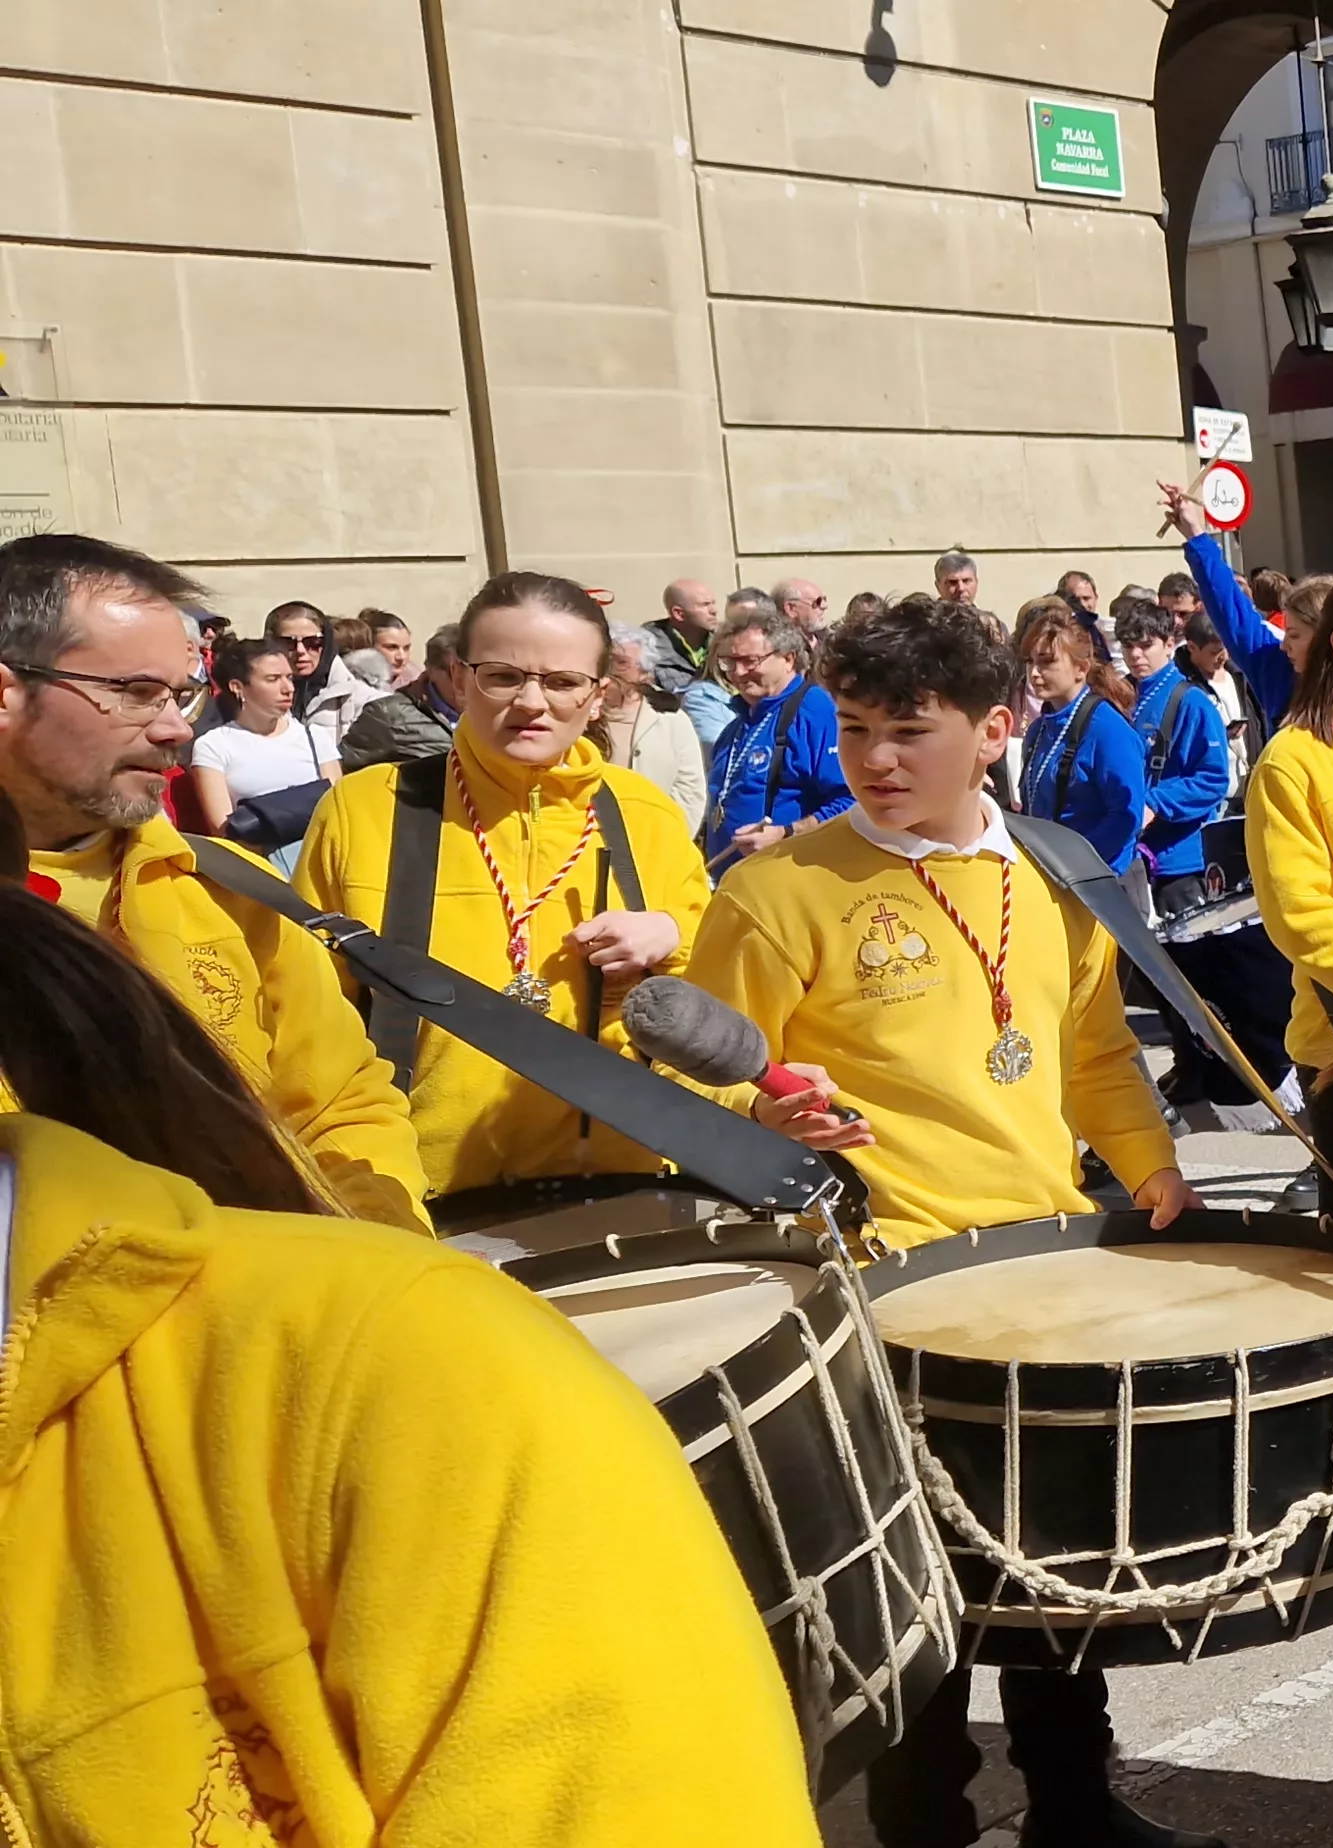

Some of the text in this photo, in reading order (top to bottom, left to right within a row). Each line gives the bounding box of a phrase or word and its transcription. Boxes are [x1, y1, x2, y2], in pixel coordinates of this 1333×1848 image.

[1061, 127, 1096, 144] PLAZA
[1056, 141, 1104, 161] NAVARRA
[841, 892, 924, 925] Banda de tambores
